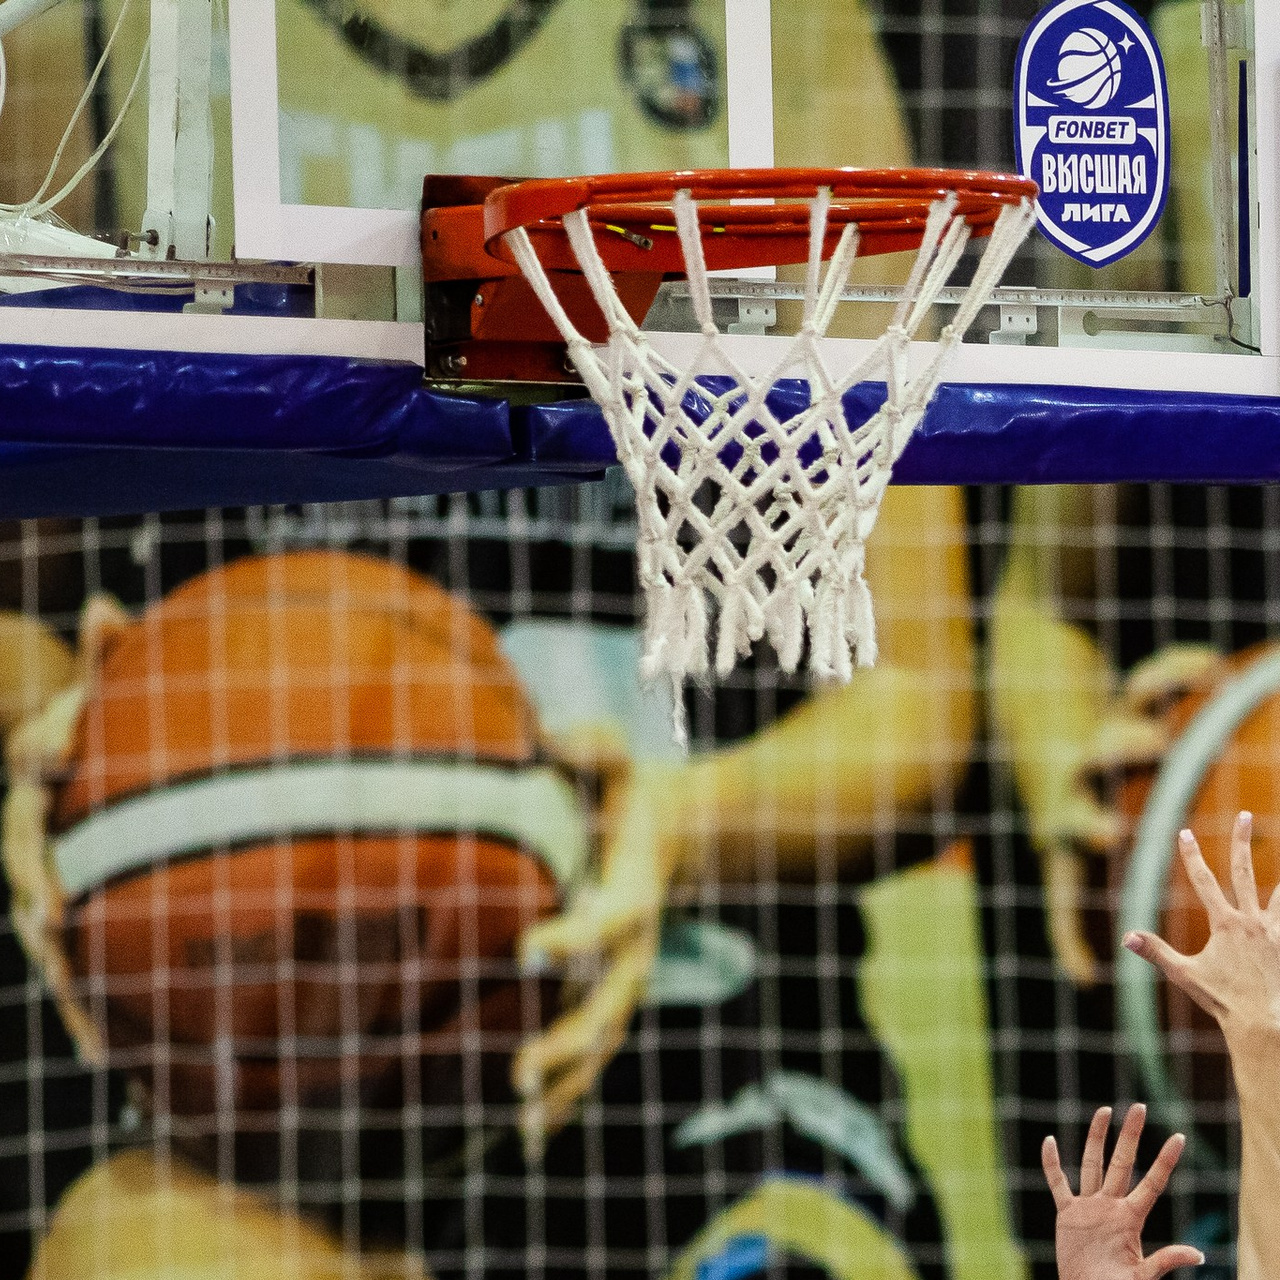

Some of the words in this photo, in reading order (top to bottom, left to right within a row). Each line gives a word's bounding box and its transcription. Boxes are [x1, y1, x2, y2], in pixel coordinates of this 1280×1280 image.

[1054, 120, 1130, 139] FONBET
[1042, 153, 1147, 194] ВЫСШАЯ
[1061, 203, 1132, 223] ЛИГА
